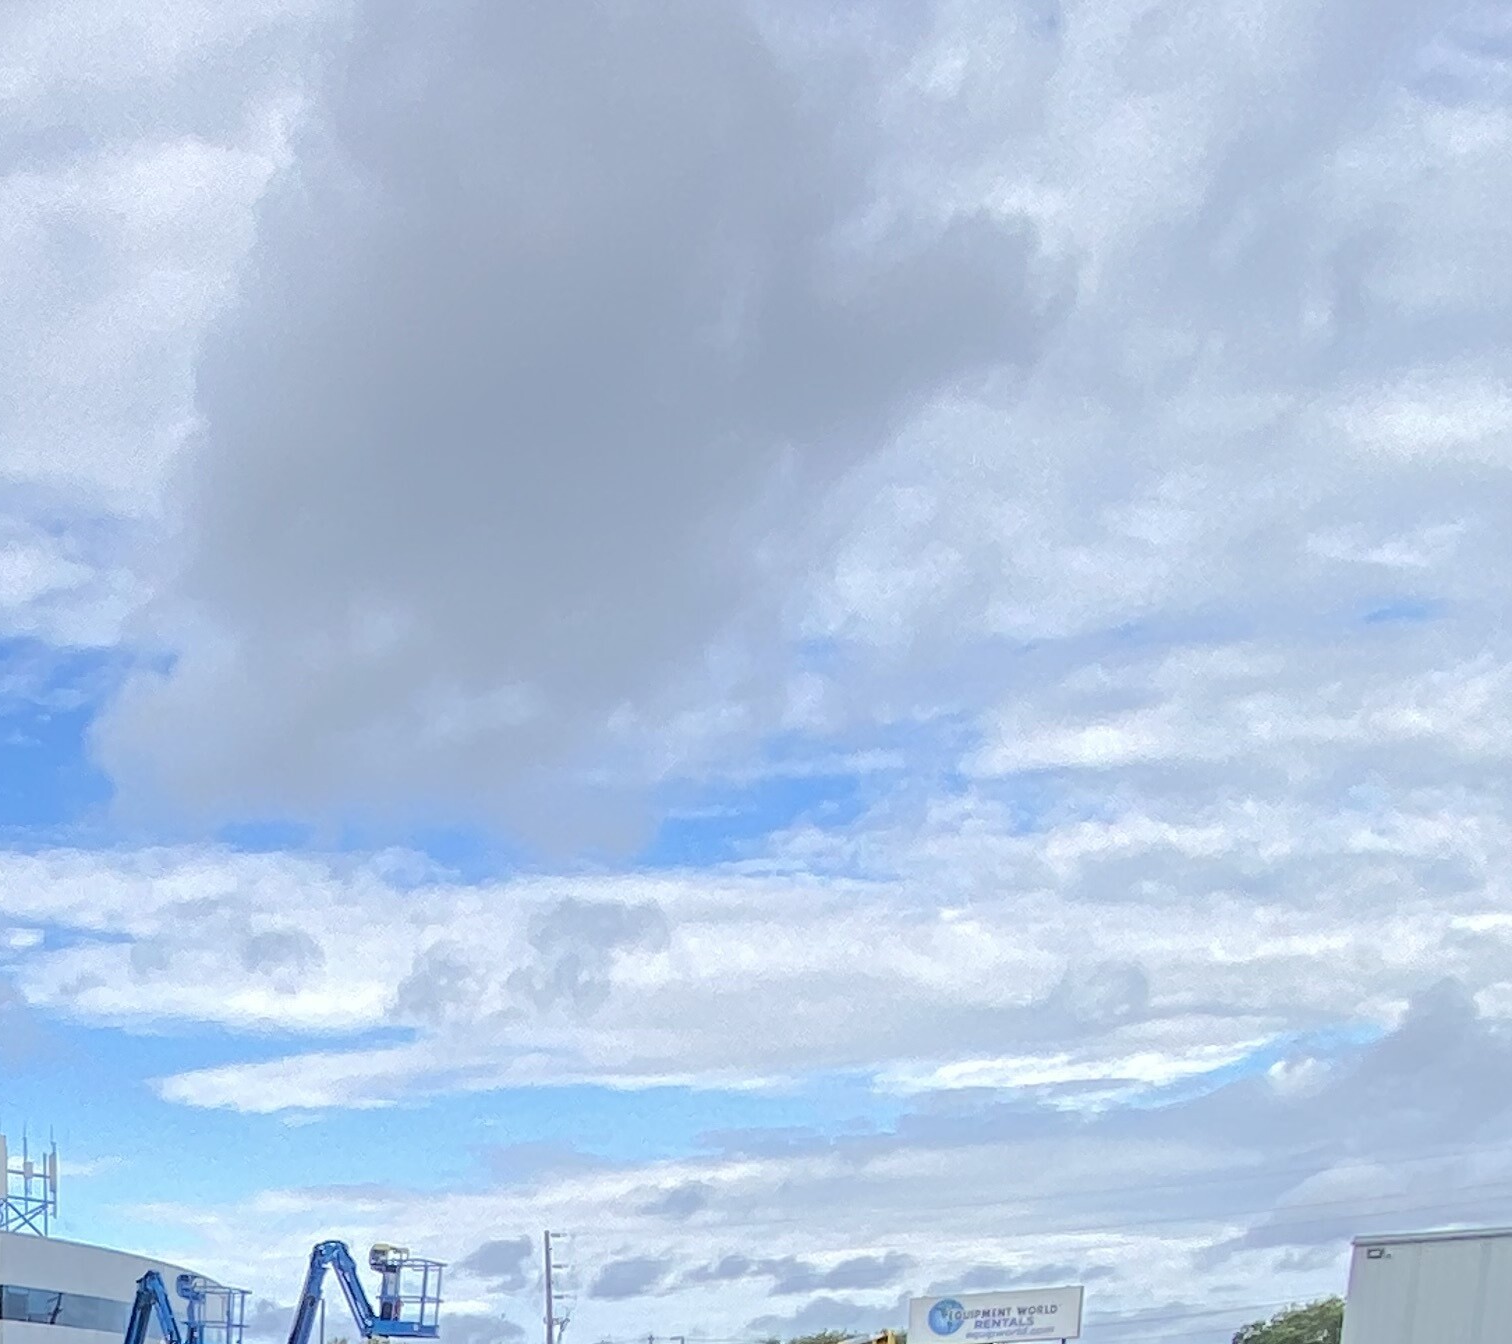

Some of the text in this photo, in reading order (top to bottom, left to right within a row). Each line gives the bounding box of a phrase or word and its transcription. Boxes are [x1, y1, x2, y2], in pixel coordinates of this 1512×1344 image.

[948, 1304, 1058, 1321] EQUIPMENT WORLD
[974, 1317, 1035, 1329] RENTALS
